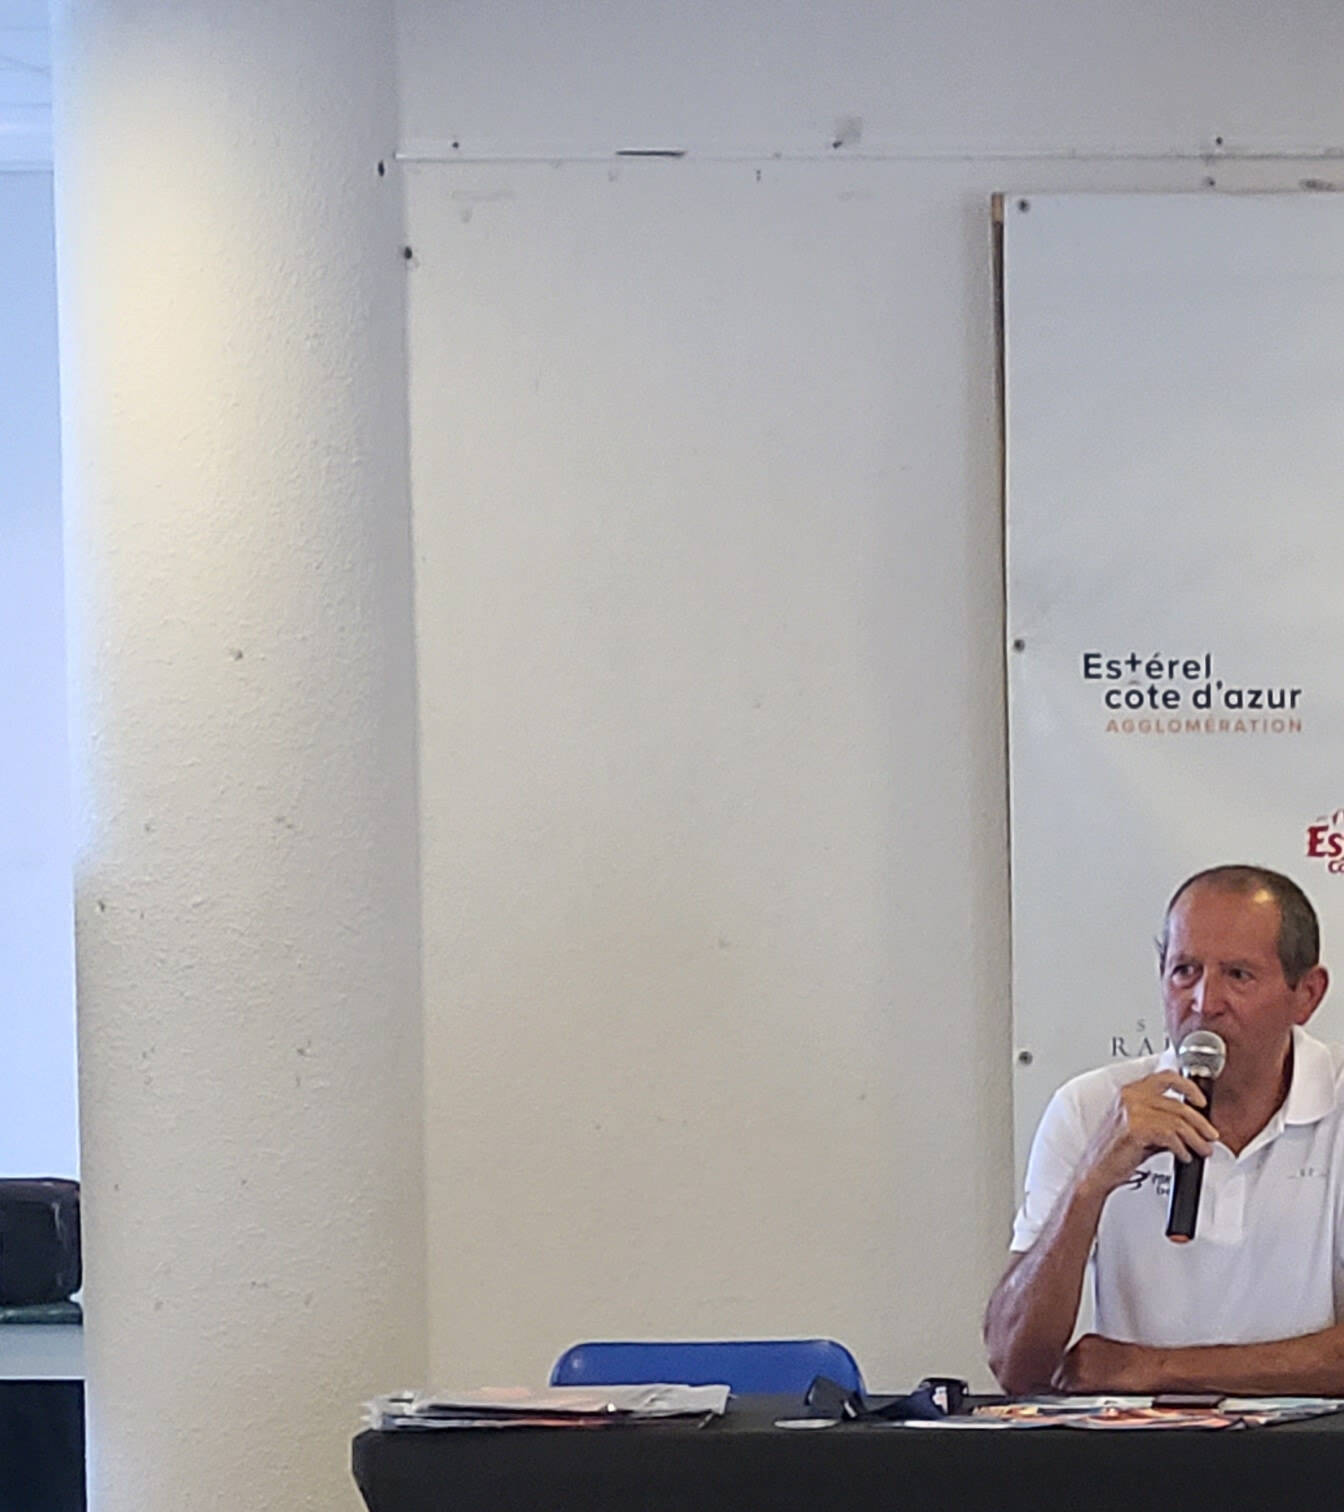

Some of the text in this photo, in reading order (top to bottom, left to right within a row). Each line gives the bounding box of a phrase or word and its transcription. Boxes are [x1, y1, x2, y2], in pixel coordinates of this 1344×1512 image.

[1105, 680, 1302, 710] côte d'azur
[1105, 714, 1302, 733] AGGLOMÉRATION
